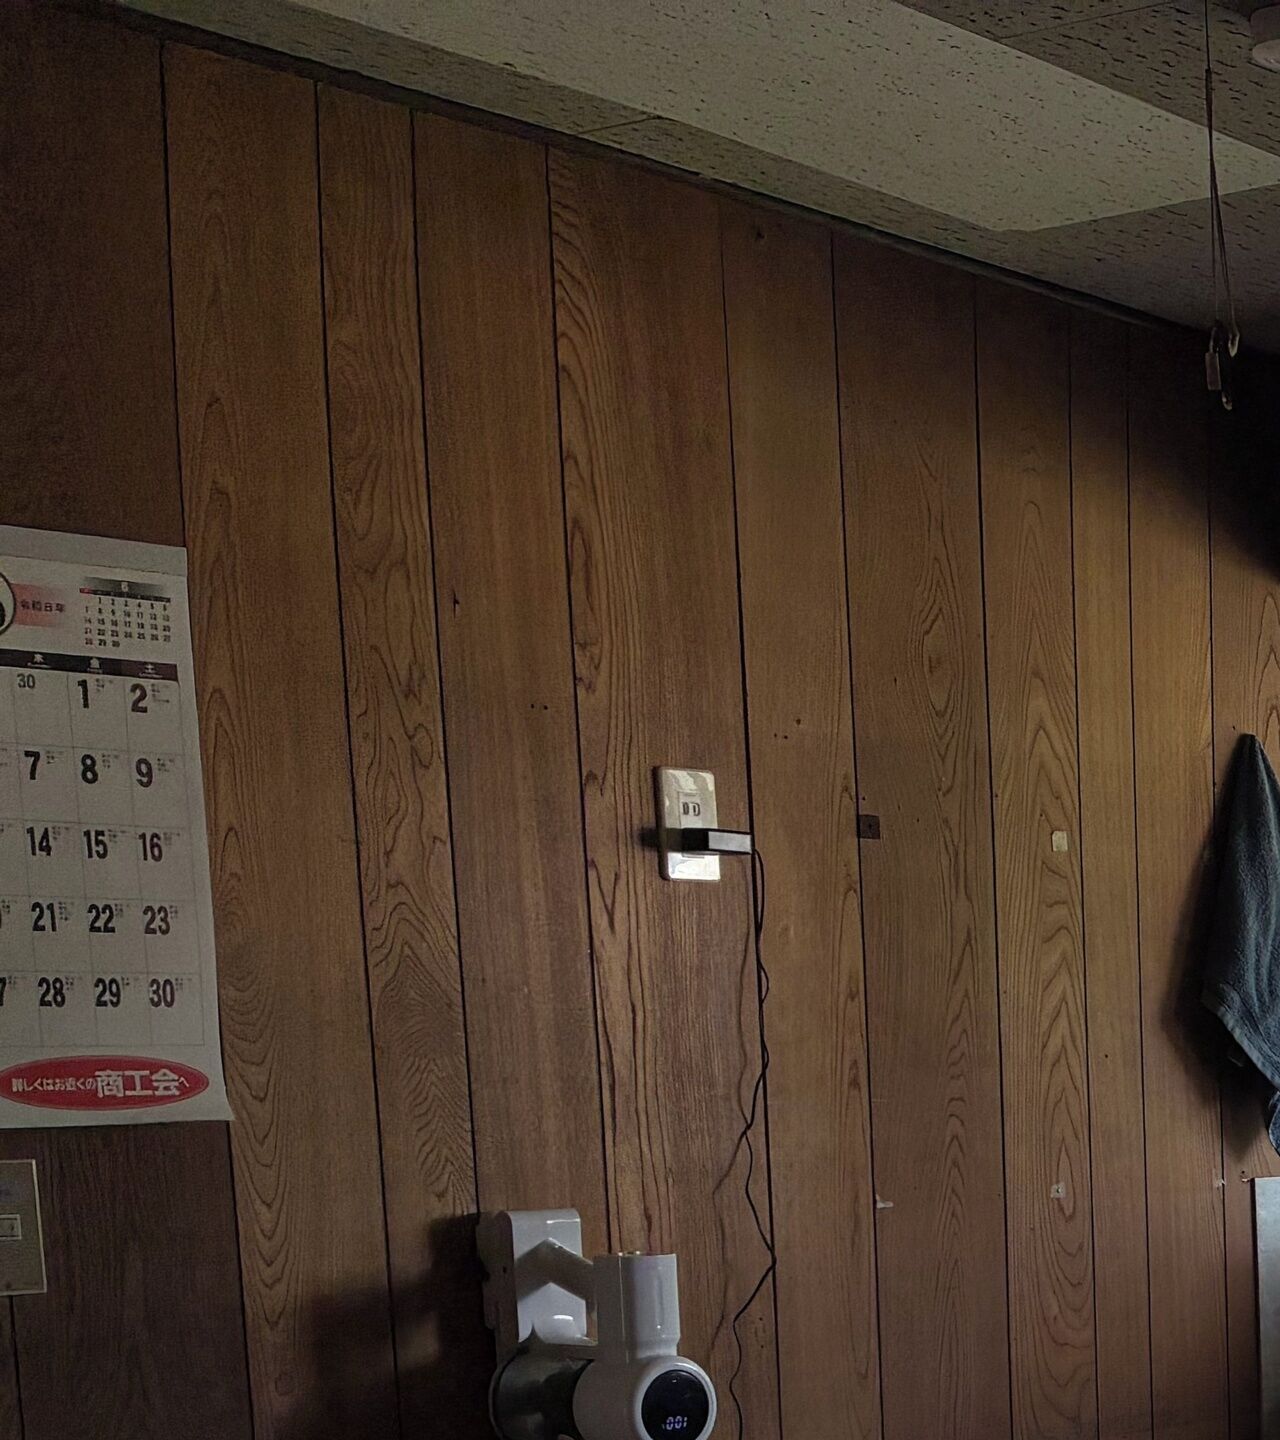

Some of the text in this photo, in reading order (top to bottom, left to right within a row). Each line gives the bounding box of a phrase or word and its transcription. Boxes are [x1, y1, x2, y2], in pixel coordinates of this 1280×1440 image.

[17, 673, 36, 689] 30
[78, 679, 89, 708] 1
[130, 683, 148, 713] 2
[24, 750, 41, 780] 7
[81, 754, 99, 784] 8
[136, 758, 153, 788] 9
[26, 826, 52, 856] 14
[83, 829, 109, 859] 15
[138, 832, 163, 862] 16
[31, 901, 57, 932] 21
[87, 903, 116, 933] 22
[142, 905, 171, 935] 23
[37, 977, 66, 1007] 28
[94, 978, 121, 1007] 29
[149, 979, 175, 1008] 30
[11, 1068, 190, 1099] 詳しくはお近くの商工会へ
